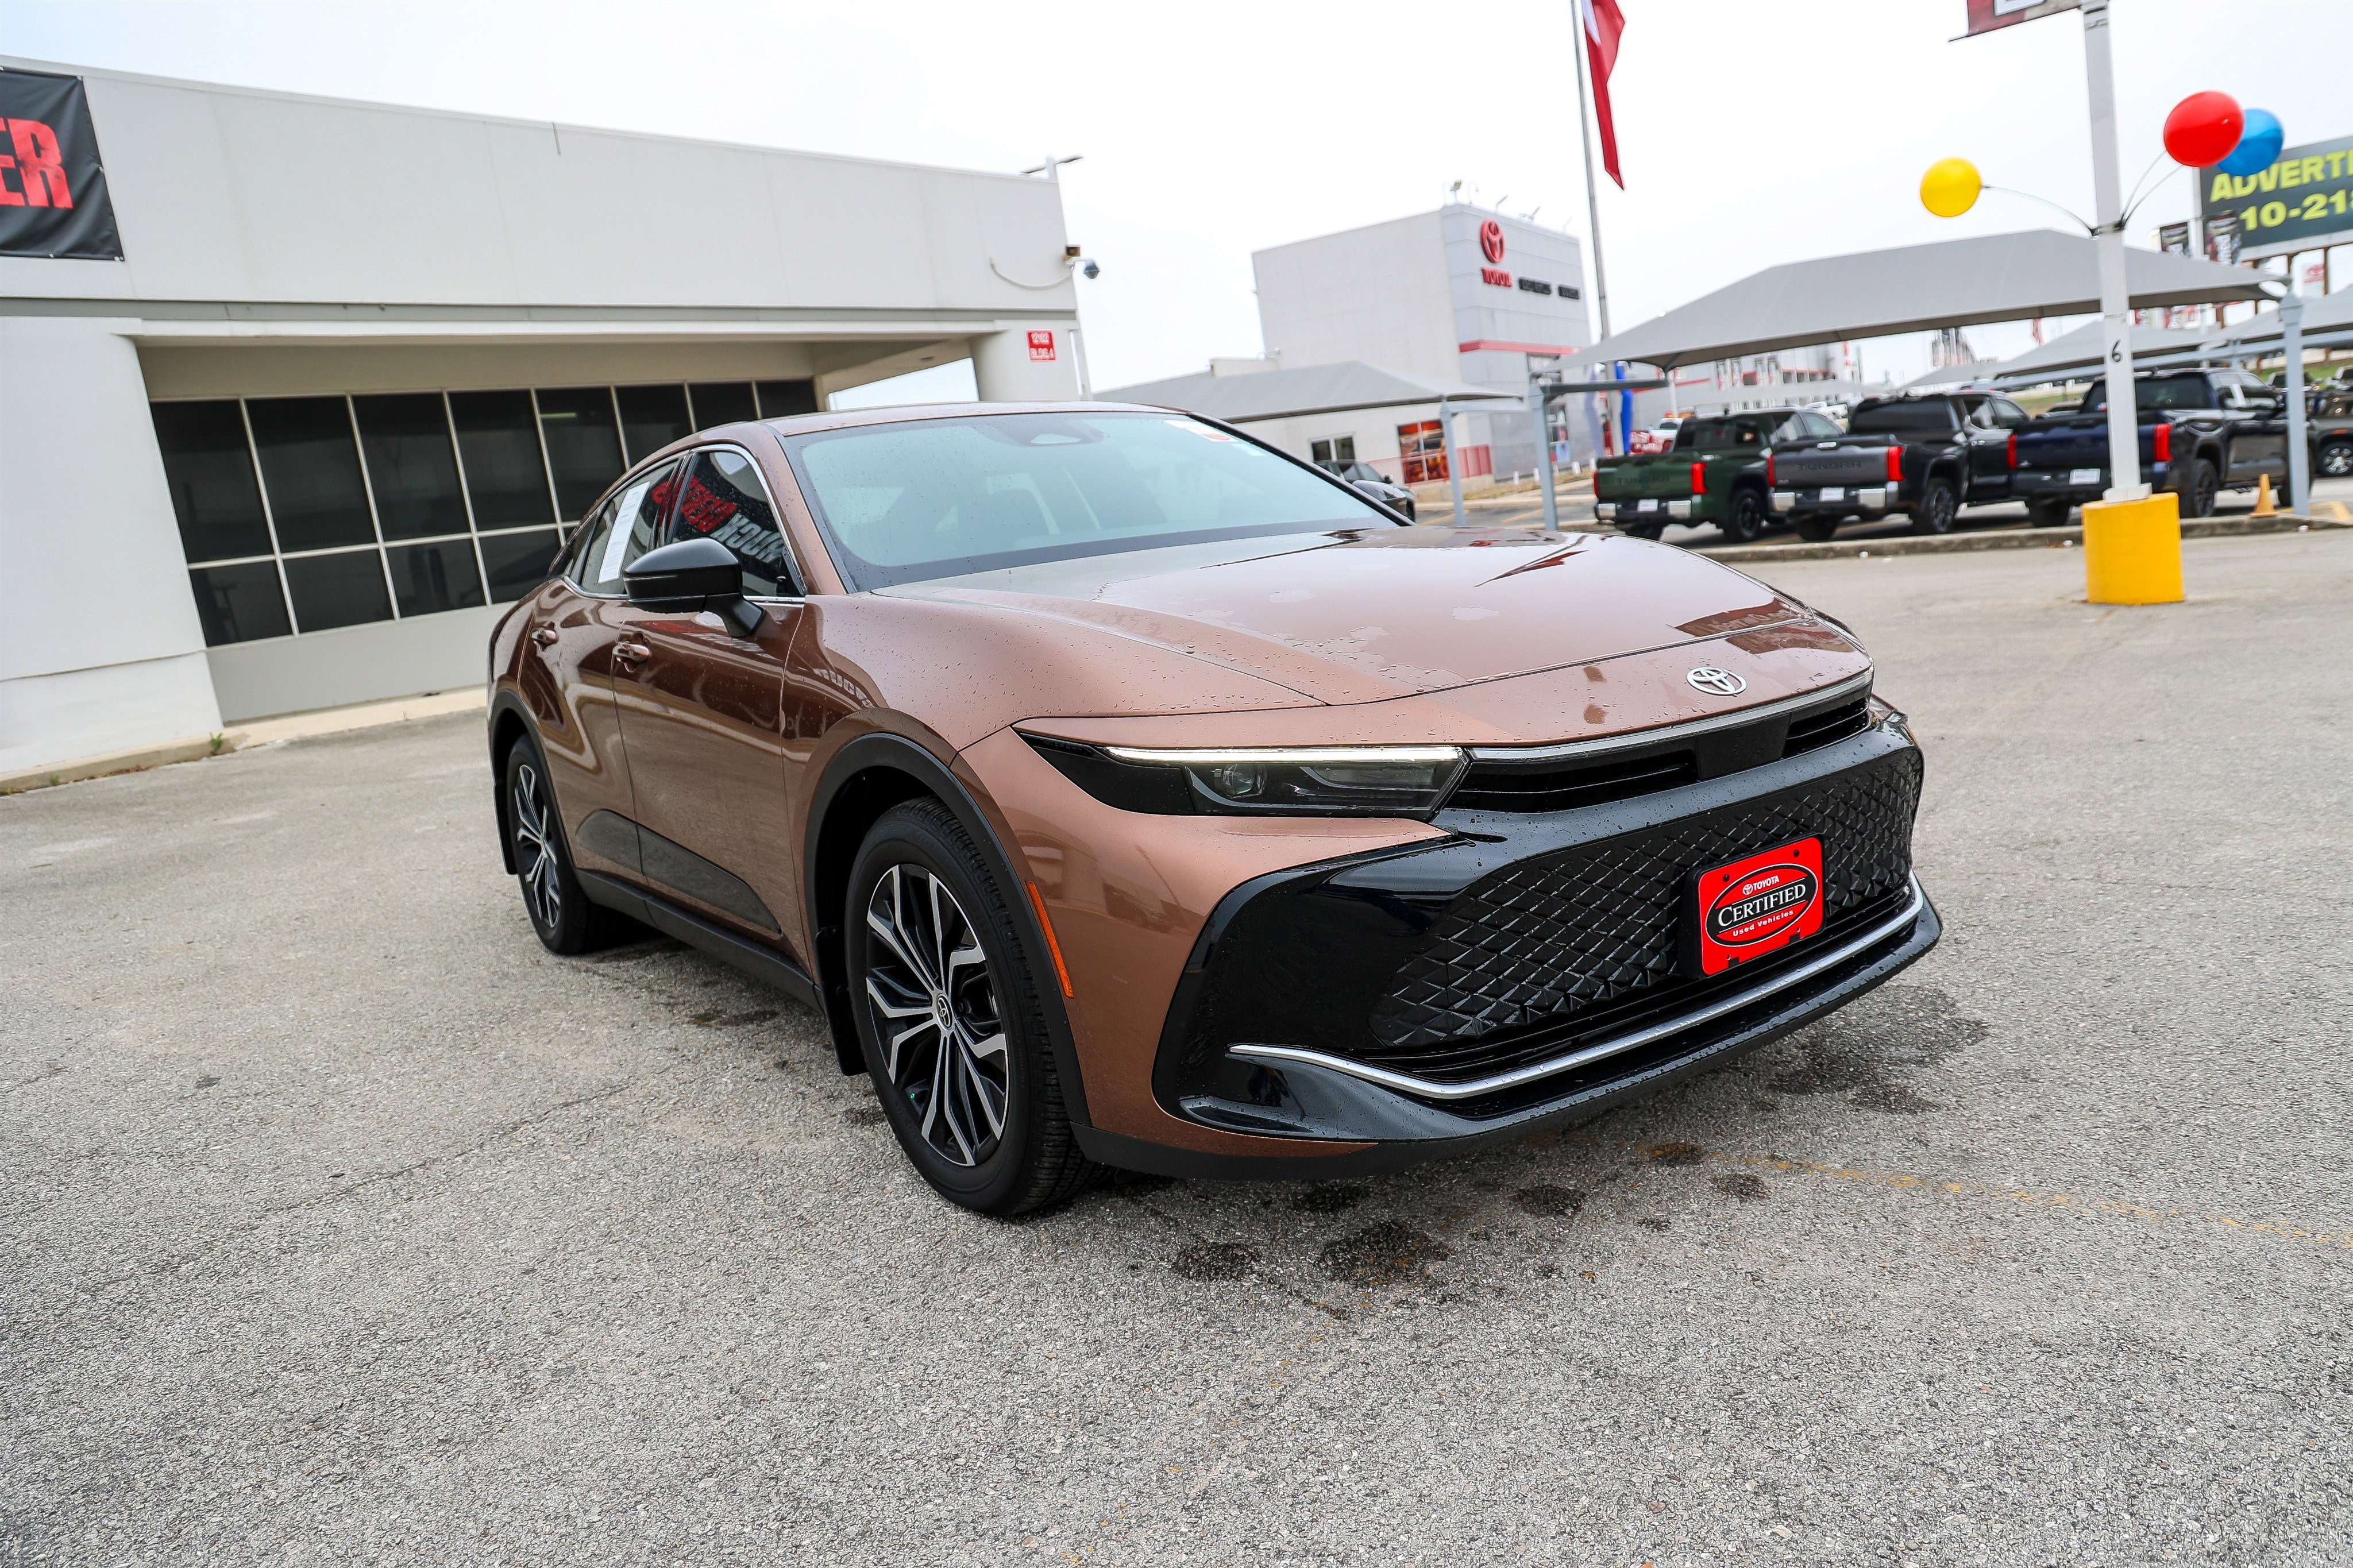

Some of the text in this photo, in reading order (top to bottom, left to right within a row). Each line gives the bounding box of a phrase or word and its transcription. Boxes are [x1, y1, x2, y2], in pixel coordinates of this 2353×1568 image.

[2111, 339, 2121, 363] 6
[1753, 875, 1780, 890] TOYOTA
[1718, 884, 1806, 927] CERTIFIED
[1733, 910, 1794, 937] Used Vehicles
